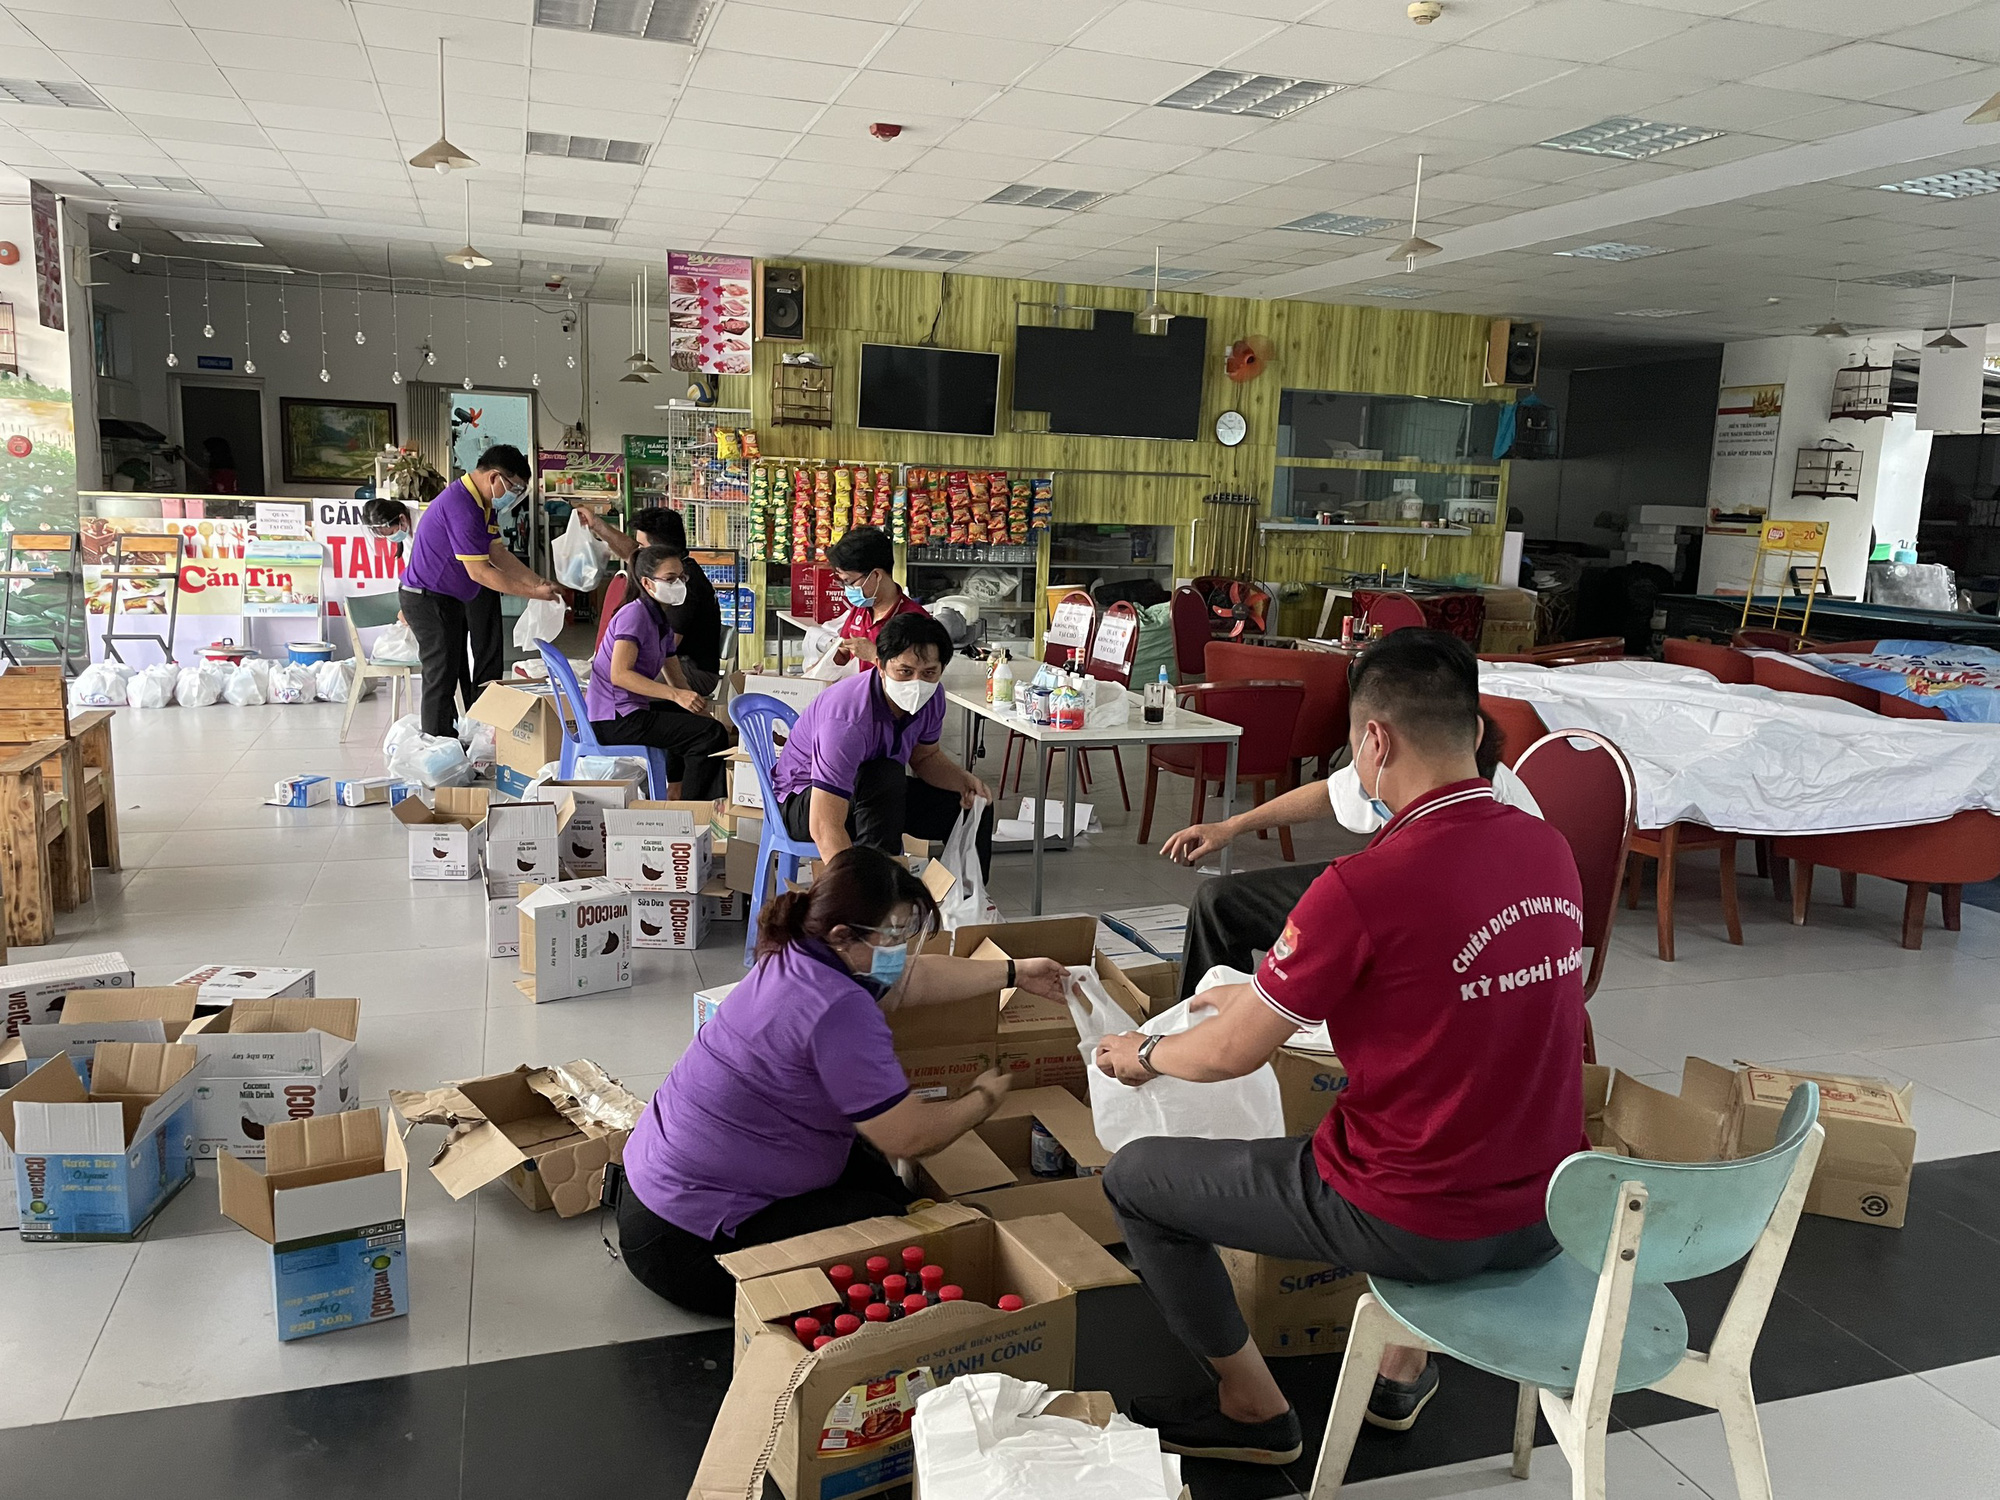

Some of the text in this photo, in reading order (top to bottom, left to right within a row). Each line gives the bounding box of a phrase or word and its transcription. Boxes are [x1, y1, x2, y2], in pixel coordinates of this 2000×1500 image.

[1804, 530, 1815, 540] 20
[327, 536, 405, 588] TẠM
[178, 564, 293, 593] Căn Tin
[637, 898, 664, 907] Sữa Dừa
[1489, 904, 1520, 935] DỊCH
[1520, 896, 1553, 917] TÌNH
[1460, 975, 1492, 1001] KỲ
[1499, 956, 1553, 992] NGHỈ
[240, 1090, 275, 1099] Milk Drink
[243, 1082, 271, 1090] Coconut
[931, 1336, 1043, 1380] HÀNH CÔNG
